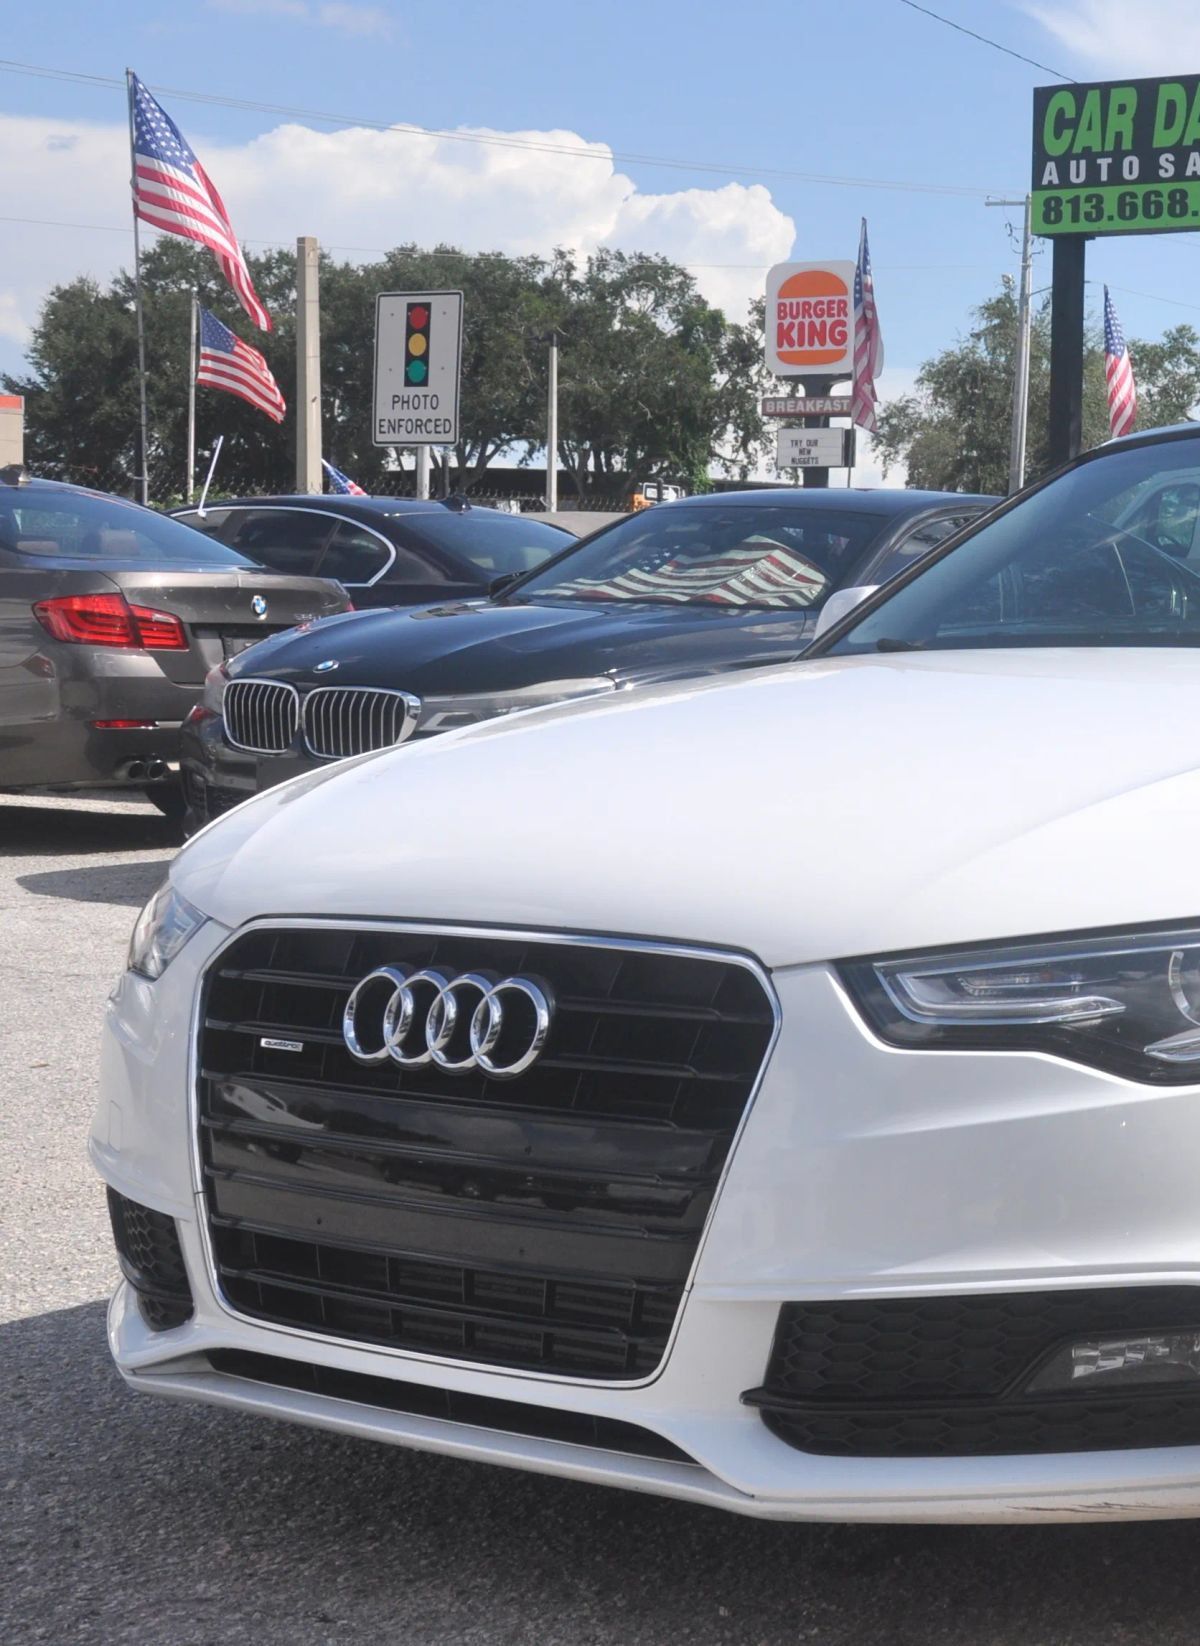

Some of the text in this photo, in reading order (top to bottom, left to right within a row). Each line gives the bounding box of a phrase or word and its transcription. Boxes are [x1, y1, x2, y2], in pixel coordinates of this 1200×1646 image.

[1042, 86, 1138, 156] CAR
[1041, 155, 1140, 185] AUTO
[777, 299, 849, 321] BURGER
[776, 319, 848, 349] KING
[391, 394, 440, 411] PHOTO
[765, 399, 850, 413] BREAKFAST
[378, 418, 452, 434] ENFORCED
[790, 439, 818, 448] TRY OUR
[799, 448, 811, 456] NEW
